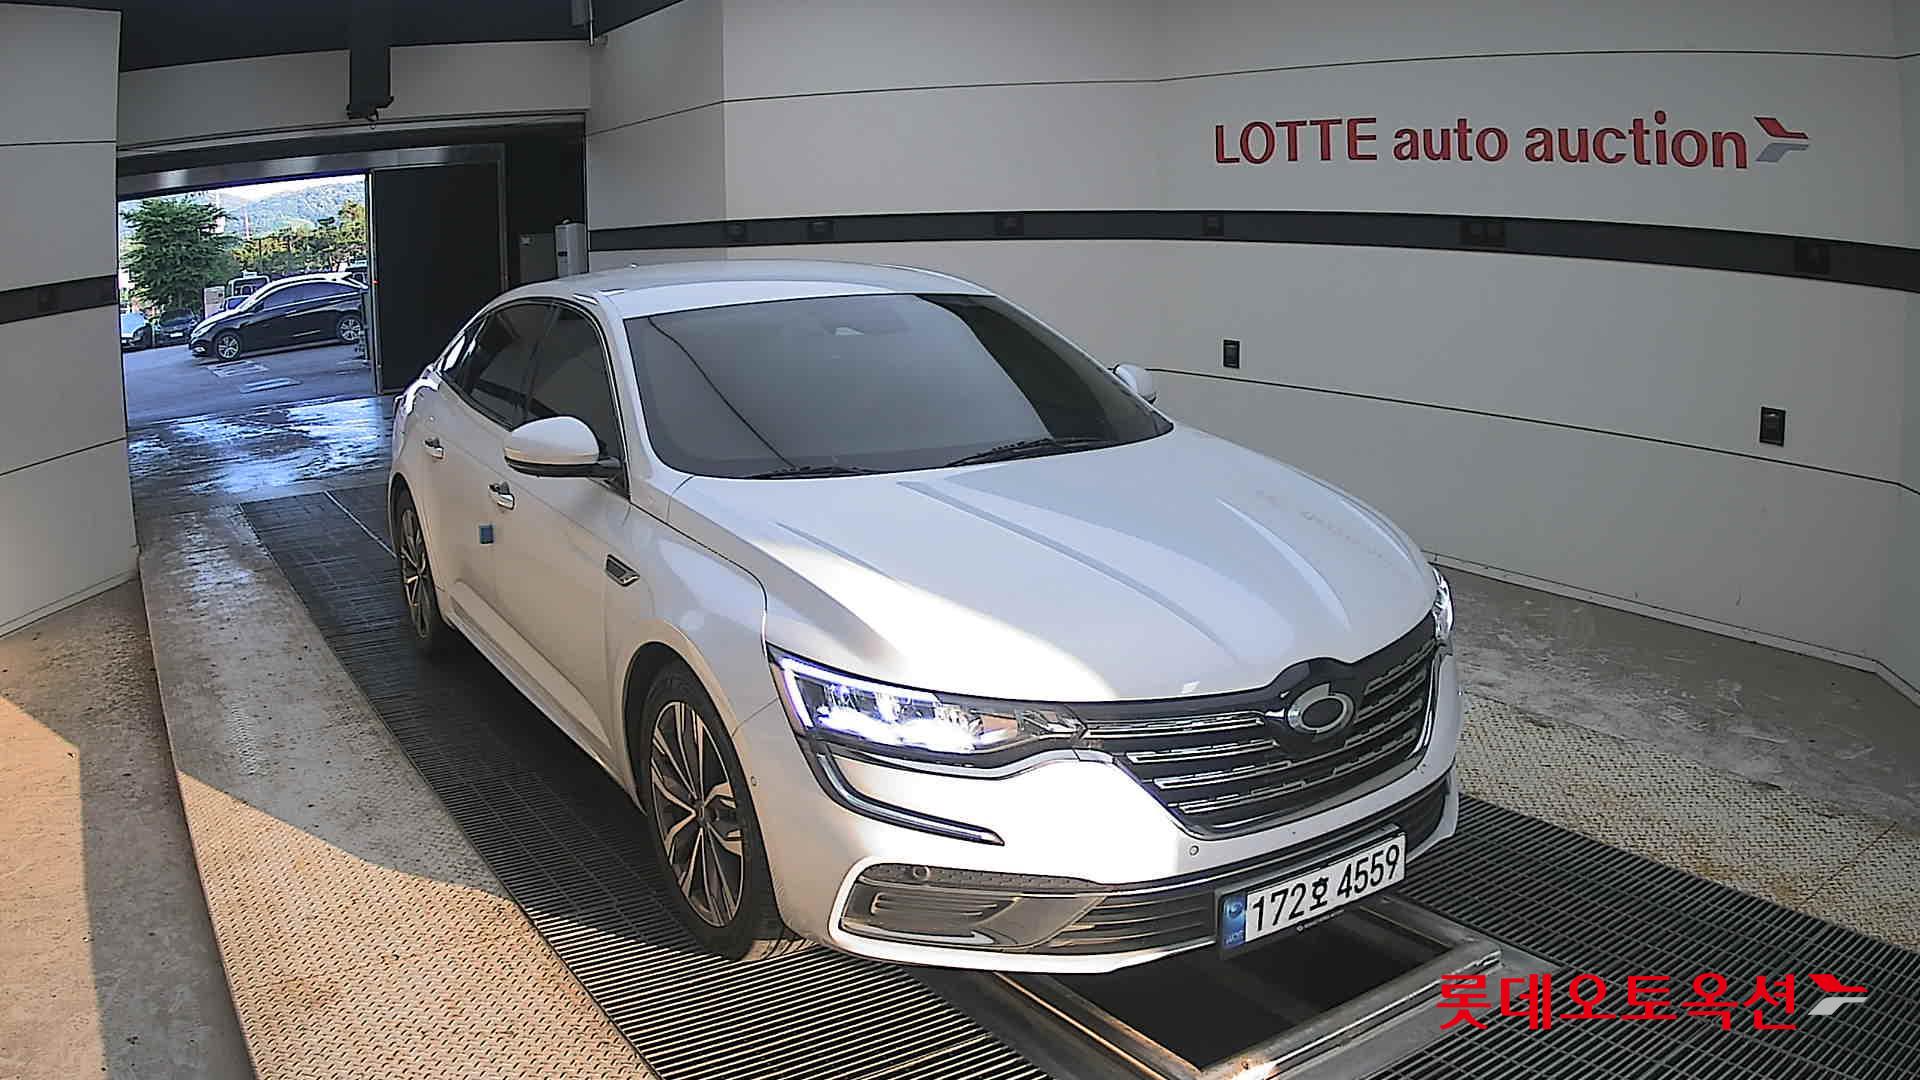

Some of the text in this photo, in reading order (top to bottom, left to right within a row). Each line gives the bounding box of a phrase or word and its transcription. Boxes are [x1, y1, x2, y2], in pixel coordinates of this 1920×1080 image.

[1215, 110, 1749, 169] LOTTE auto auction
[1252, 844, 1401, 932] 172호 4559
